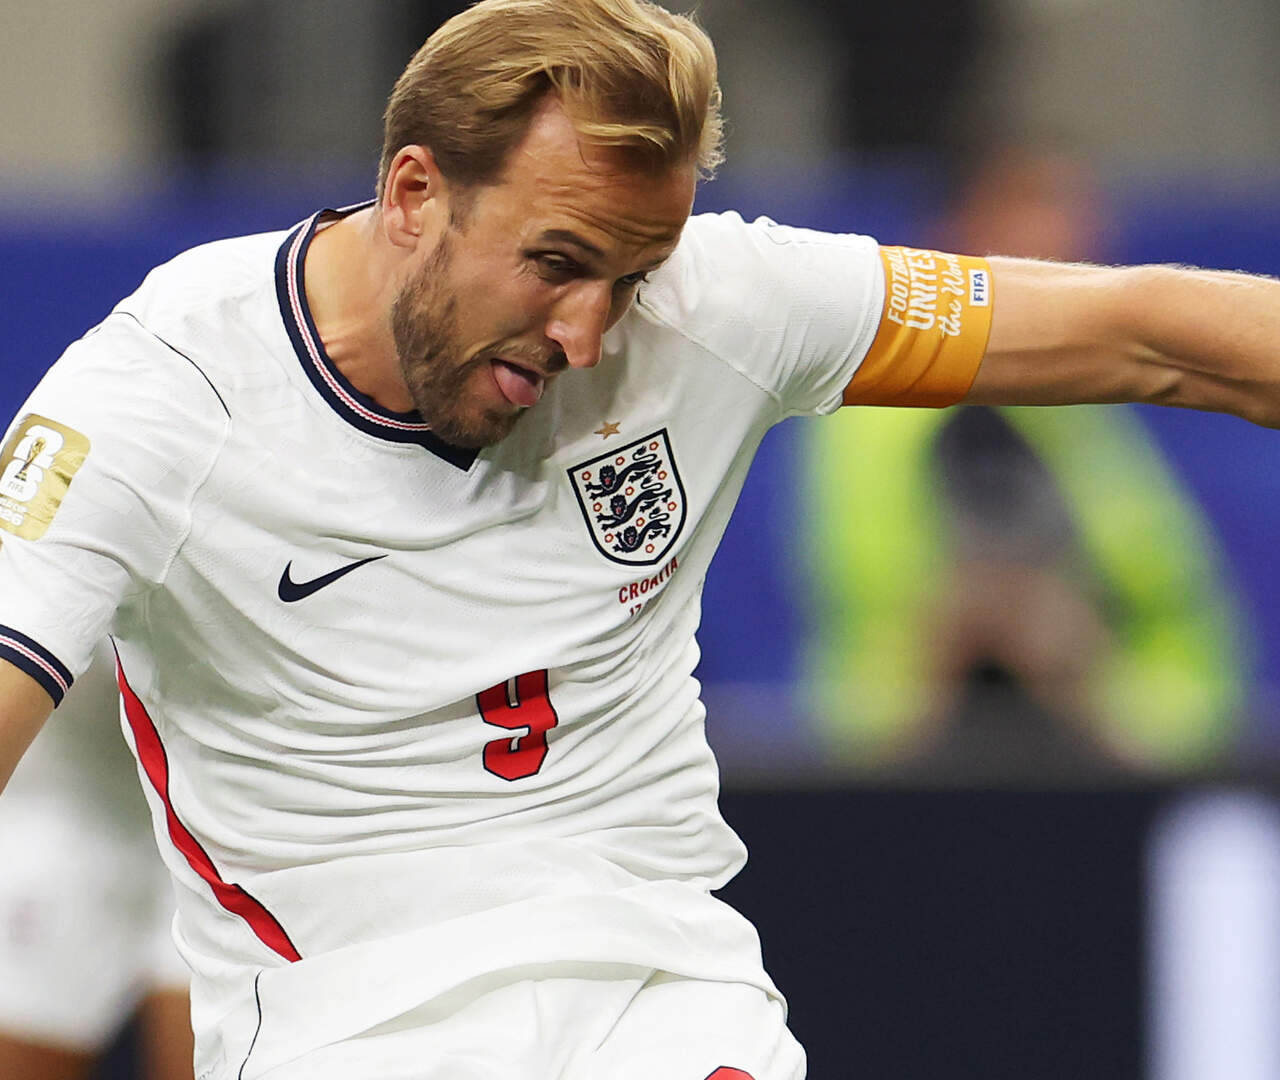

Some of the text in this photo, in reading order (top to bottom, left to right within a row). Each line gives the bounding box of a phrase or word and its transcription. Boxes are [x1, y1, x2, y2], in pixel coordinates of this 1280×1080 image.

[904, 248, 937, 330] UNITES
[973, 272, 985, 302] FIFA
[937, 299, 963, 338] the
[476, 668, 559, 782] 9
